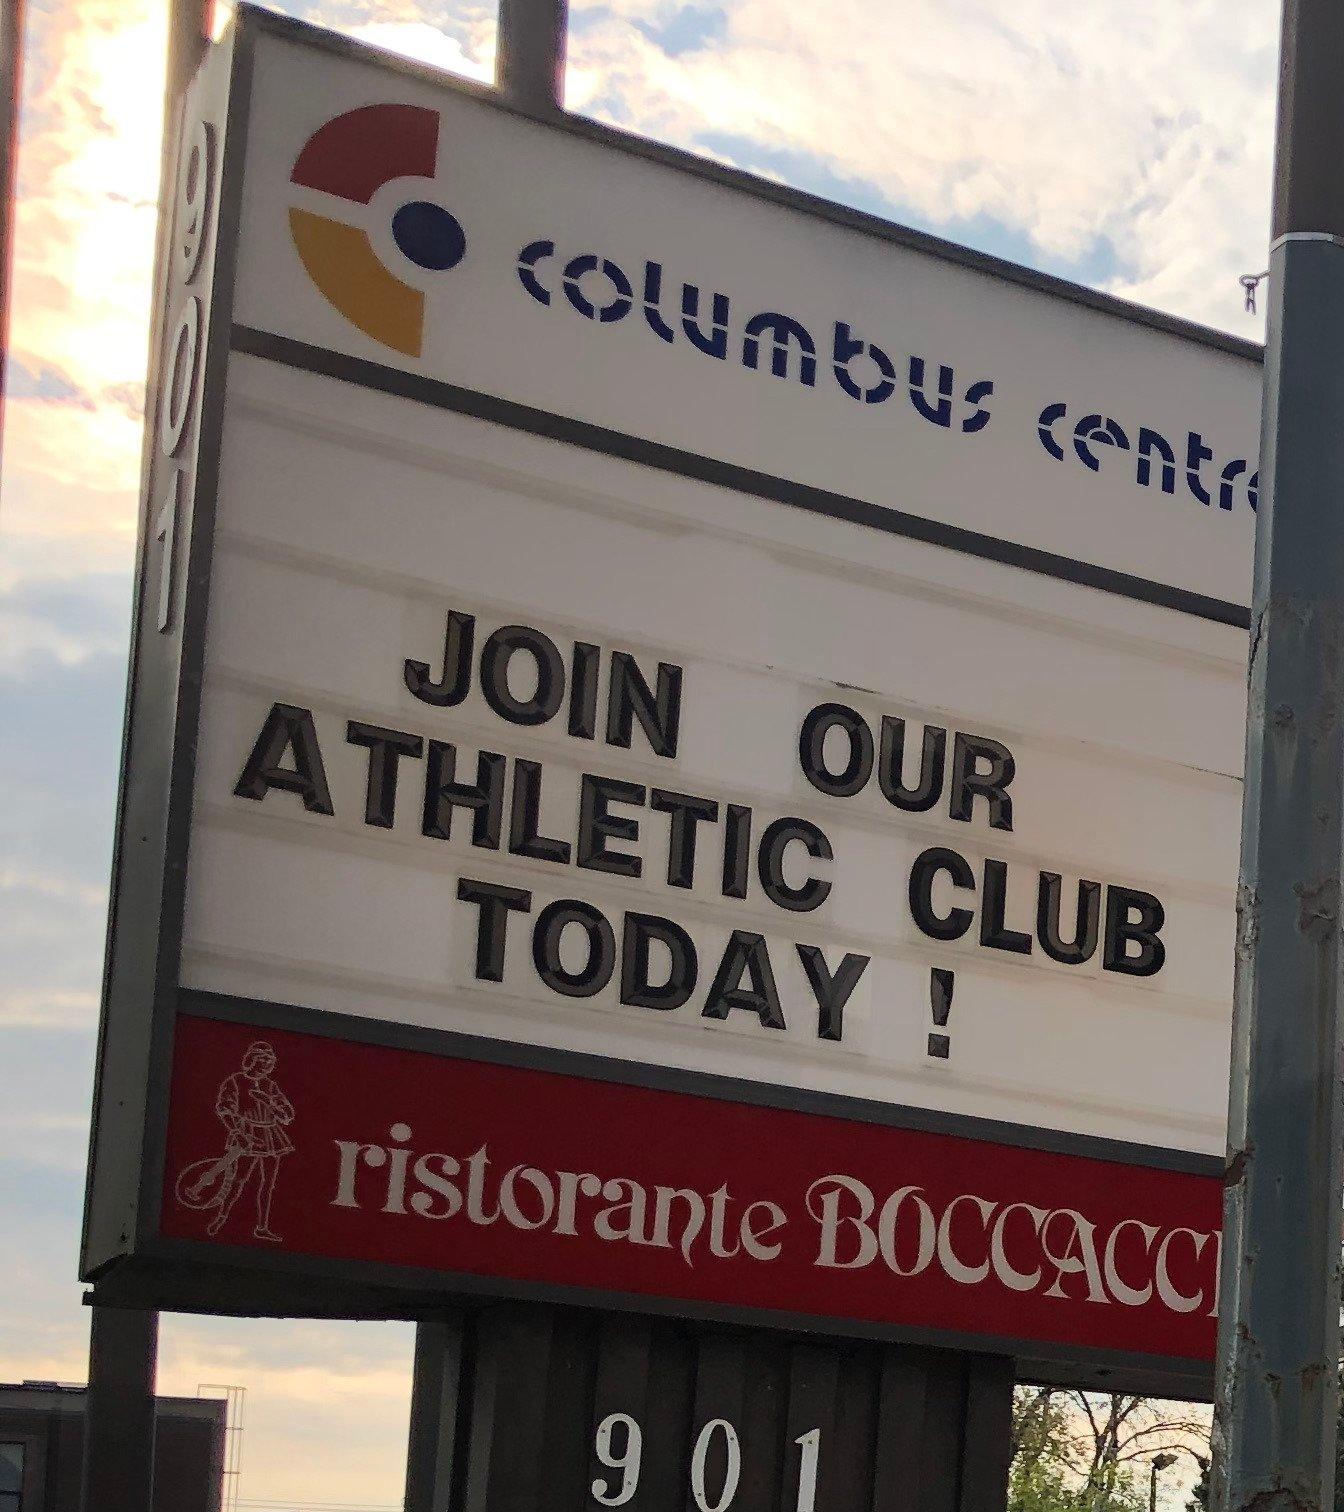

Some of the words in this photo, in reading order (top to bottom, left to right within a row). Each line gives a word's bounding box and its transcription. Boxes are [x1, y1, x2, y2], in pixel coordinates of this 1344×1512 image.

[515, 238, 995, 436] columbus
[402, 608, 685, 760] JOIN
[796, 701, 1018, 834] OUR
[233, 701, 836, 915] ATHLETIC
[907, 846, 1168, 978] CLUB
[455, 877, 872, 1044] TODAY
[332, 1122, 790, 1268] ristorante
